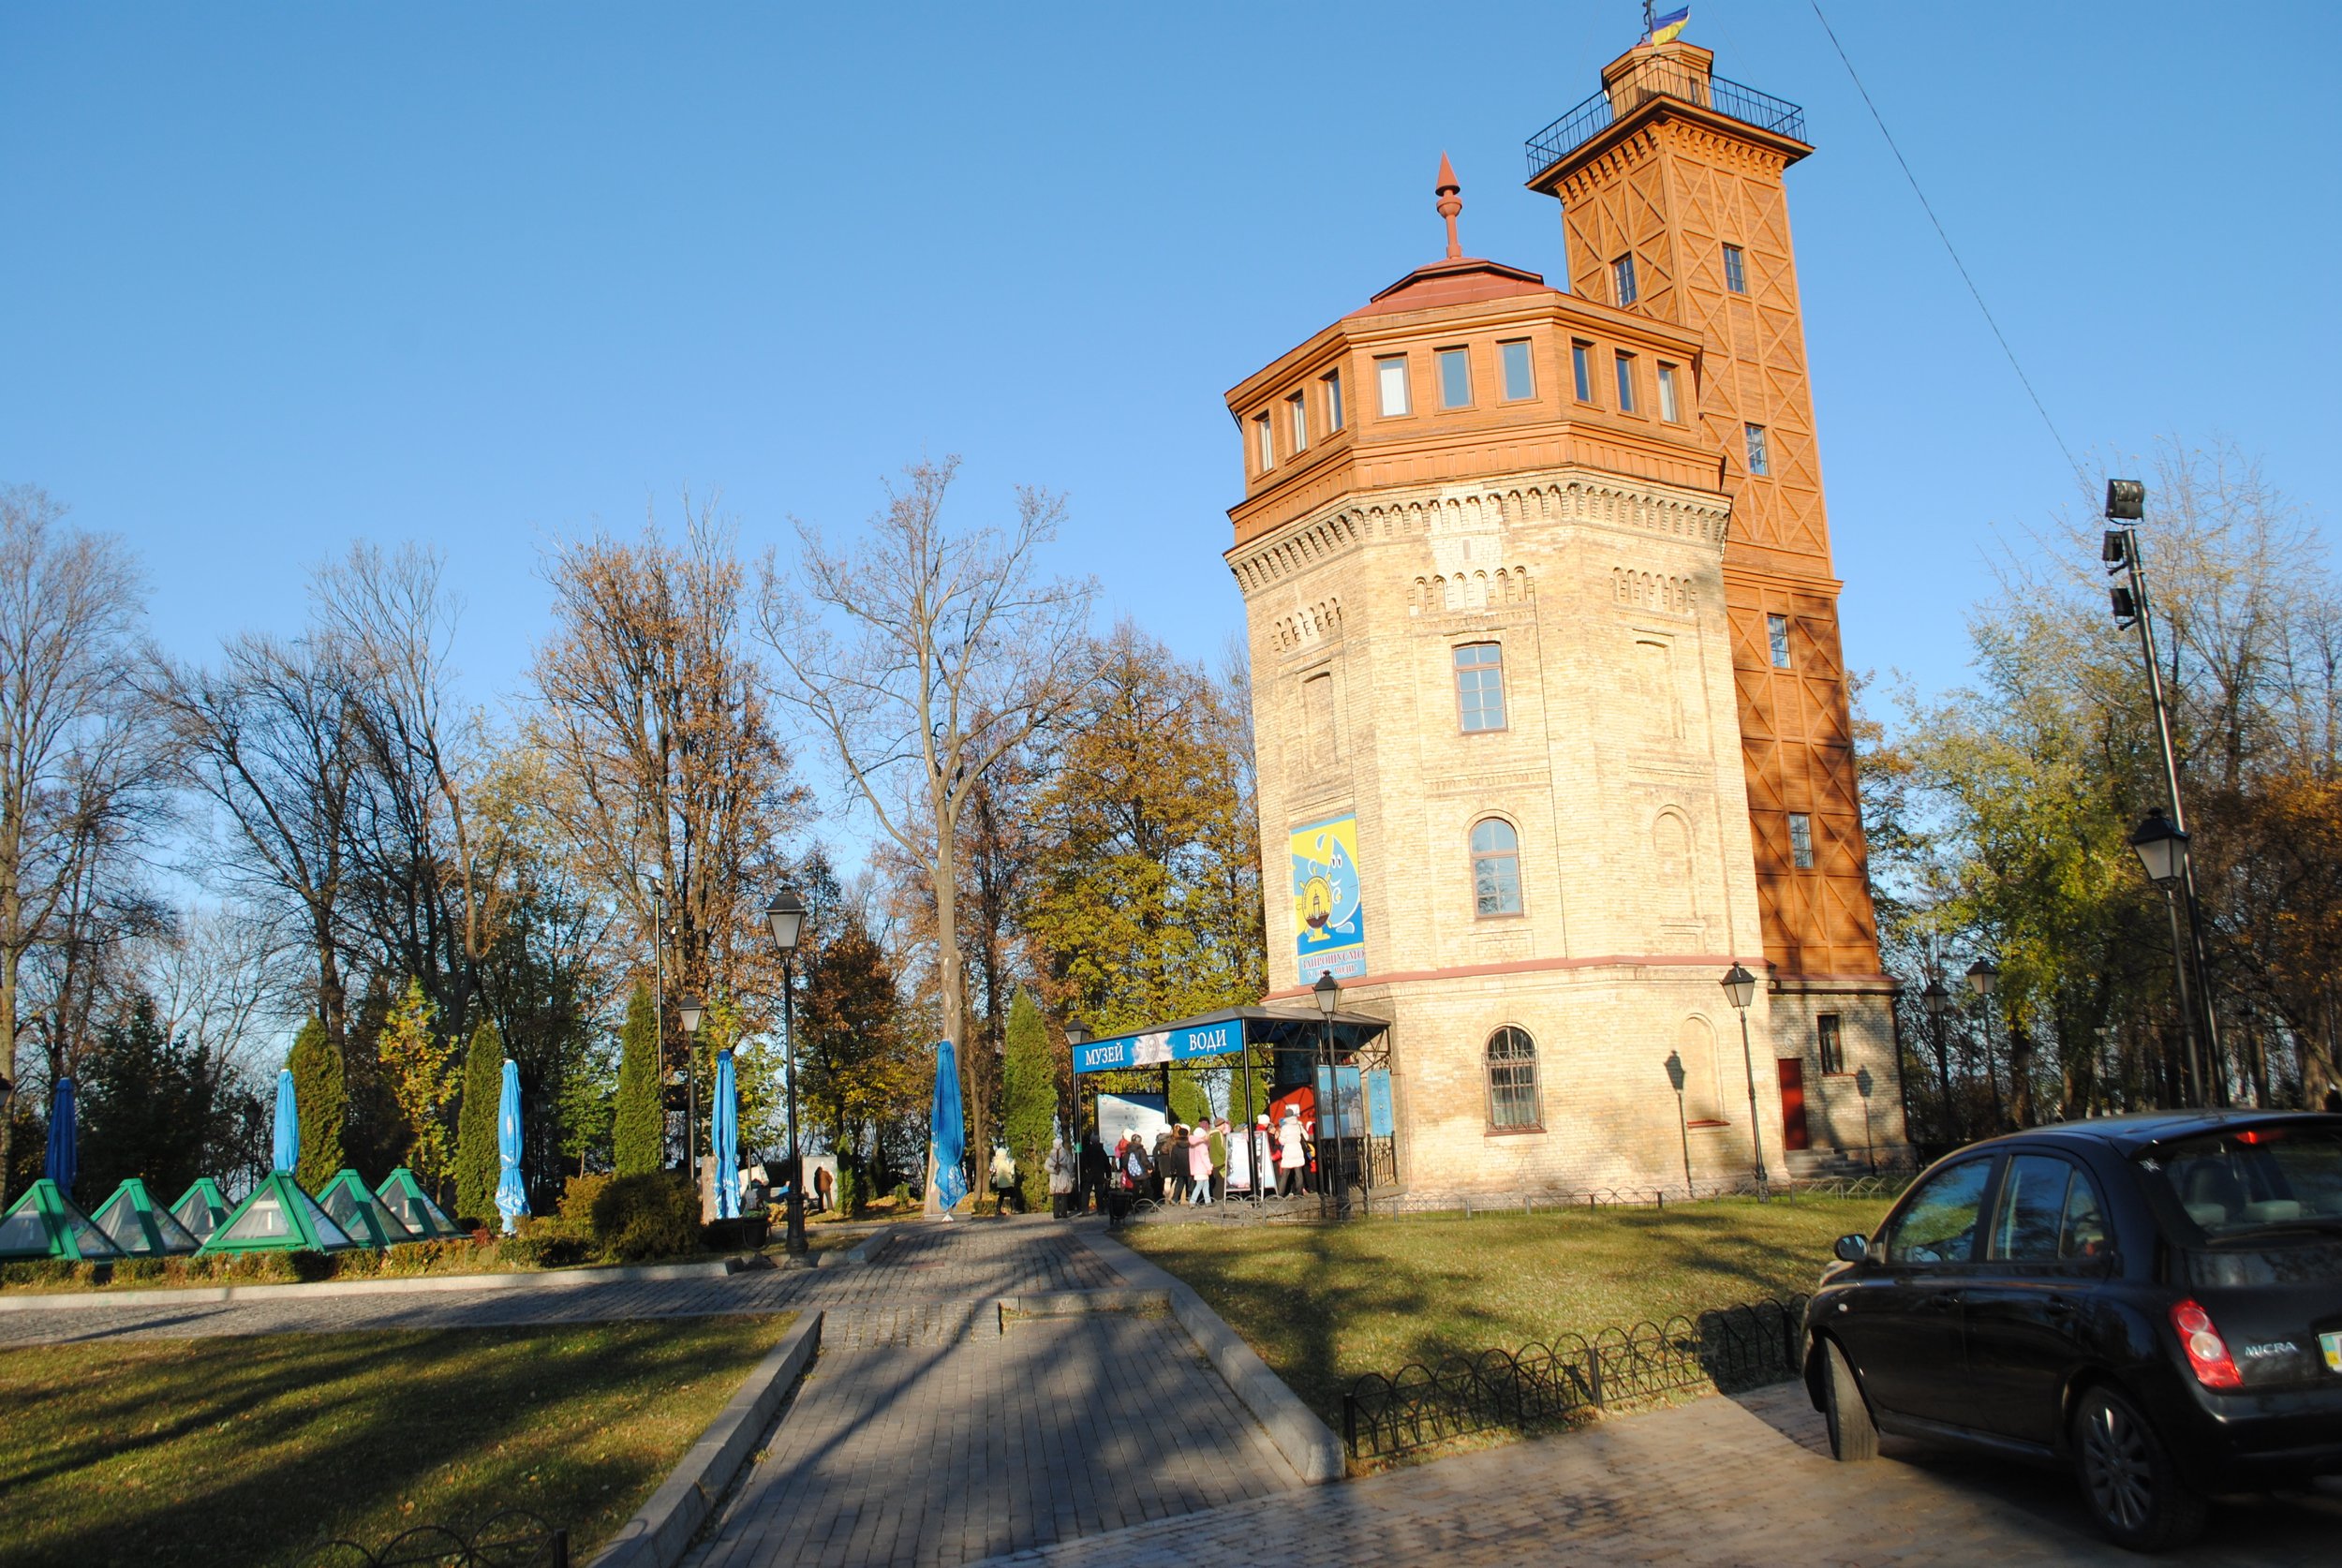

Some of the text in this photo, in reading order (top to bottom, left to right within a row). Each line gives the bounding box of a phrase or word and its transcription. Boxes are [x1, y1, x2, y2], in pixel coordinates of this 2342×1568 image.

[1085, 1029, 1227, 1066] МУЗЕЙ ВОДИ
[2245, 1341, 2300, 1358] MICRA
